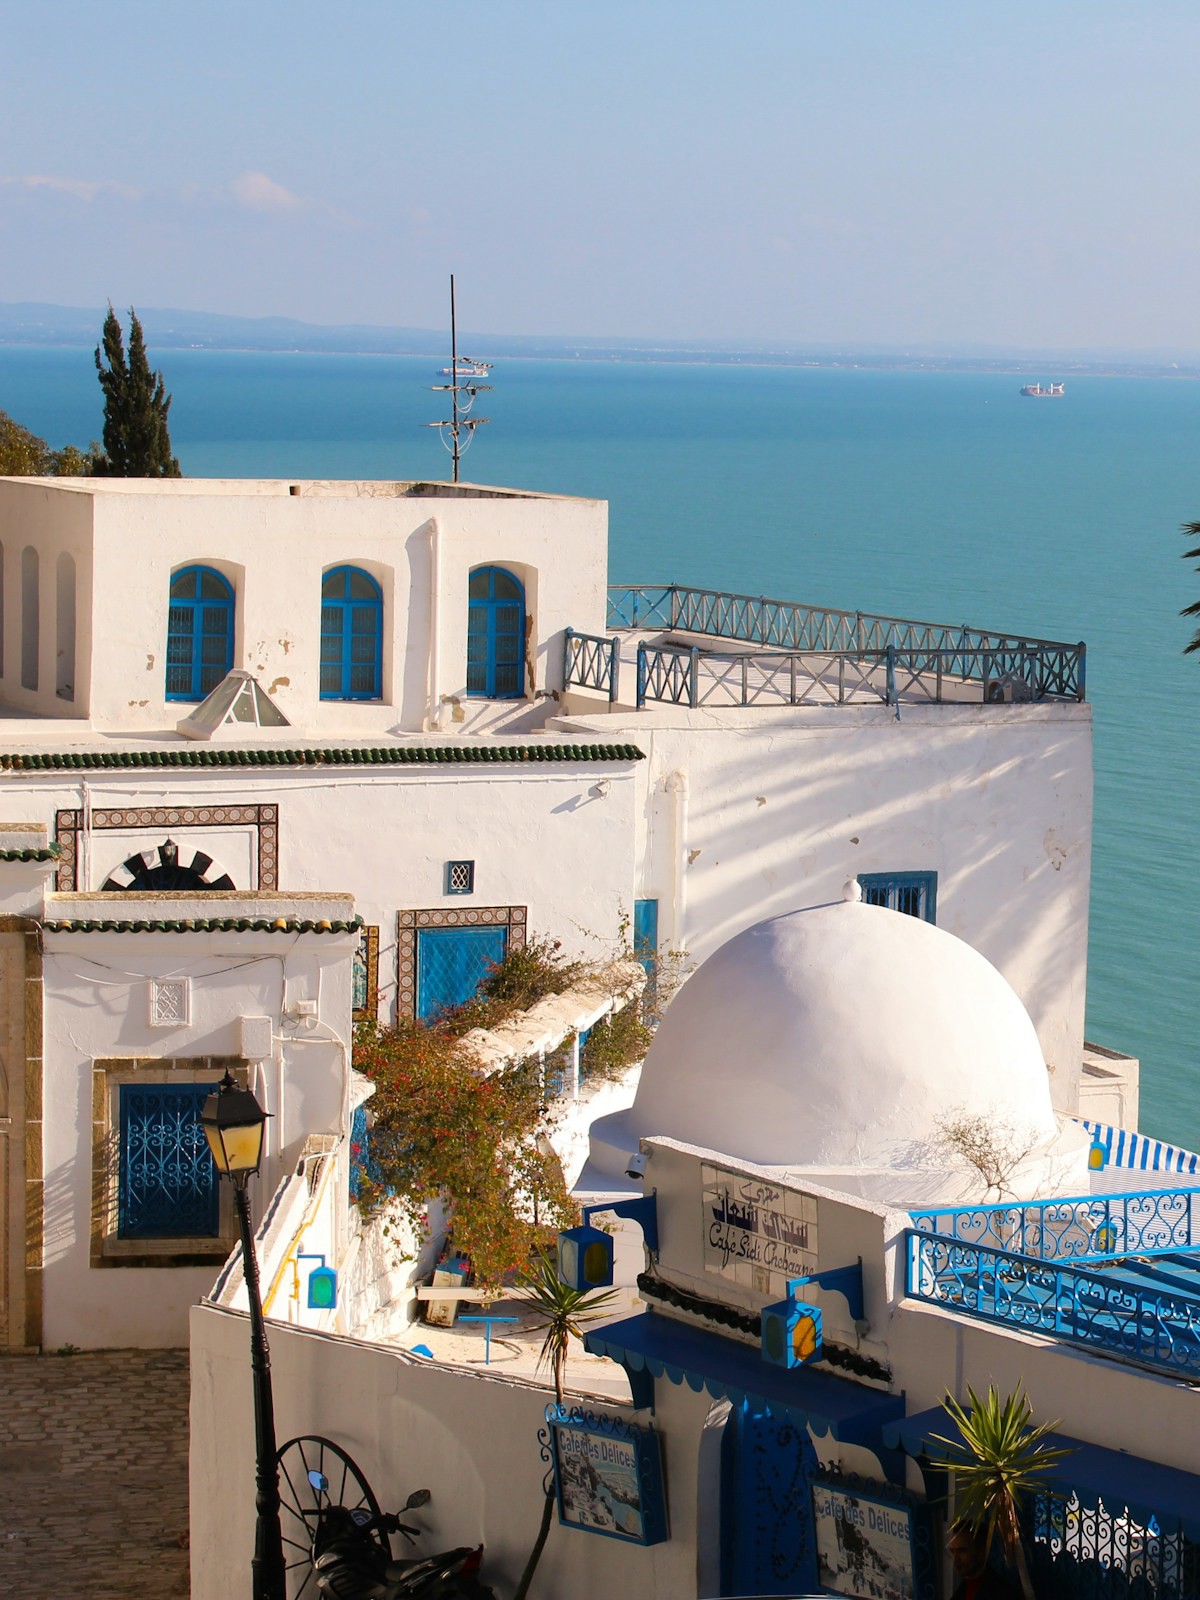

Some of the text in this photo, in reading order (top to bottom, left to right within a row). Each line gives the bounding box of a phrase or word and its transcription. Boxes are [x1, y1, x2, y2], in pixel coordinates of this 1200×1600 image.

[709, 1222, 815, 1276] Café Sidi Chebaane
[559, 1430, 636, 1469] Café des Délices
[845, 1501, 866, 1528] des
[868, 1506, 910, 1541] Délices
